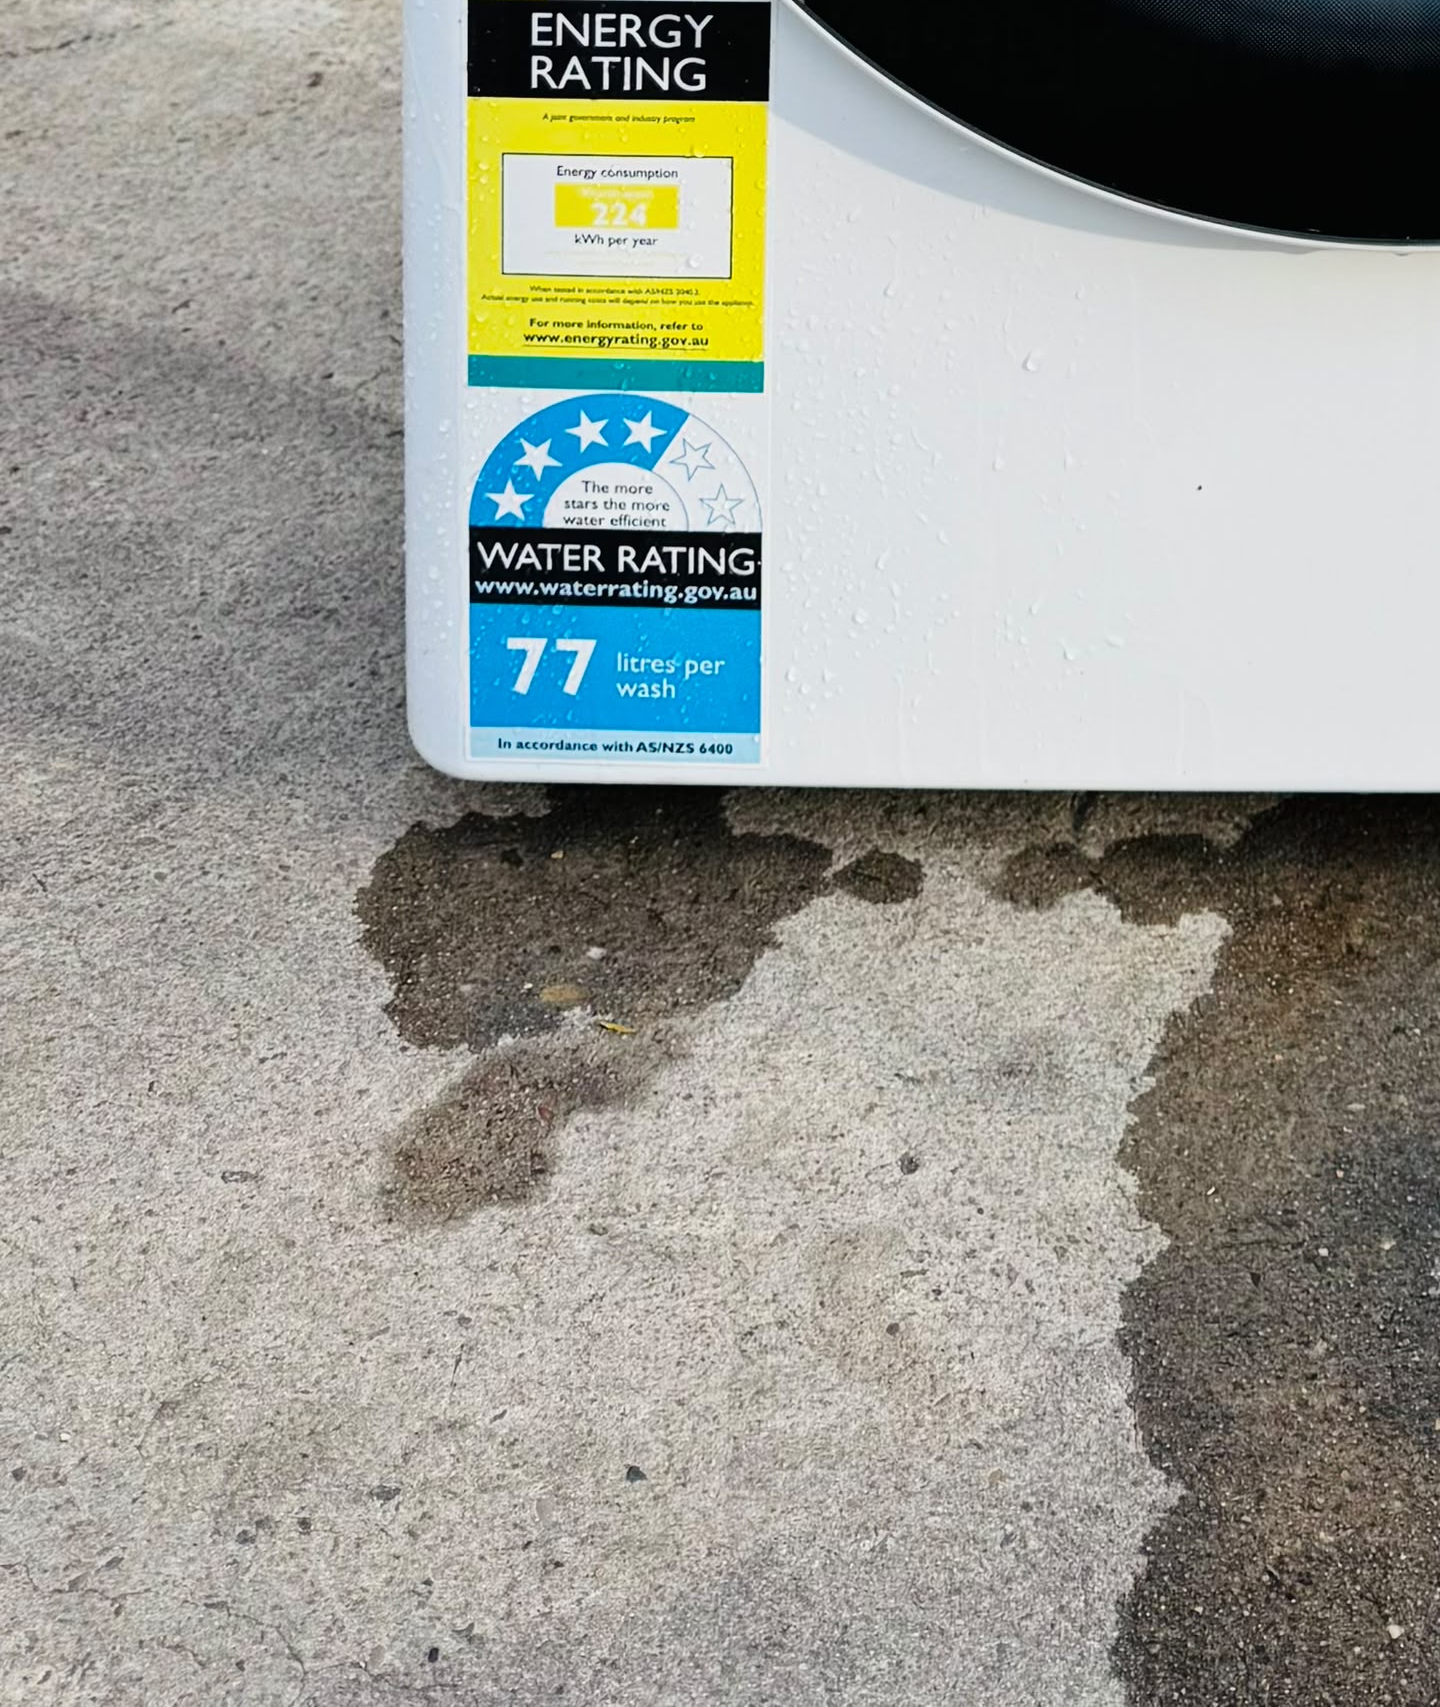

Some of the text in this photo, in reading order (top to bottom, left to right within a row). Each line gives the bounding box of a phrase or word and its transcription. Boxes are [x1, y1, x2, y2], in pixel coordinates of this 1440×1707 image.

[530, 11, 715, 50] ENERGY
[530, 55, 708, 93] RATING
[556, 165, 679, 180] Energy consumption
[574, 233, 659, 248] kWh per year
[529, 317, 704, 332] For more information, refer to
[523, 332, 710, 349] www.energyrating.gov.au
[581, 480, 654, 496] The more
[563, 498, 671, 513] stars the more
[562, 514, 668, 529] water efficient
[476, 541, 756, 576] WATER RATING
[474, 578, 758, 605] www.waterrating.gov.au
[506, 636, 726, 697] 77 litres per
[616, 678, 676, 700] wash
[497, 737, 734, 756] In accordance with AS/NZS 6400
